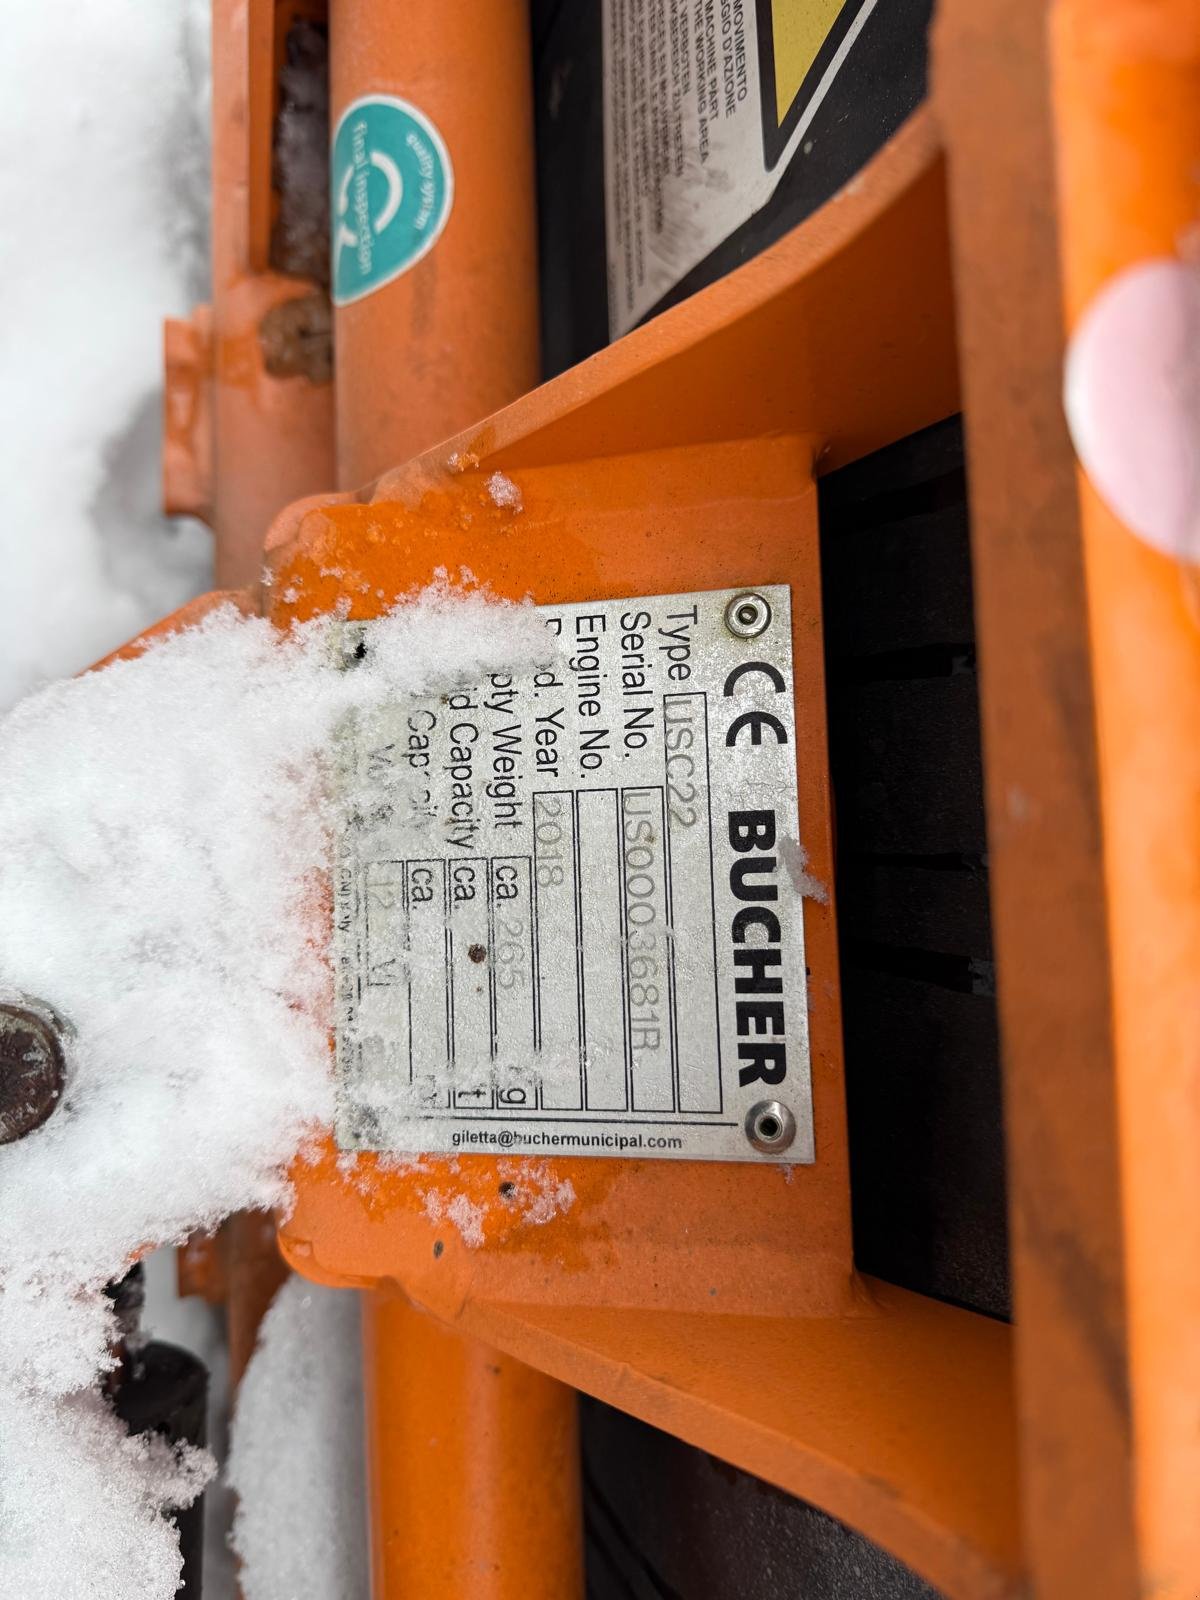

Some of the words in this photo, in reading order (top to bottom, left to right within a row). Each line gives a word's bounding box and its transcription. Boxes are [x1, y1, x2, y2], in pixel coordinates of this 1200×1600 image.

[694, 32, 707, 112] WORKING
[704, 0, 716, 76] MACHINE
[708, 78, 719, 121] PART
[723, 37, 736, 118] D'AZIONE
[352, 121, 369, 169] final
[700, 118, 709, 164] AREA
[354, 170, 375, 275] inspection
[569, 614, 608, 717] Engine
[620, 611, 653, 696] Serial
[658, 605, 698, 681] Type
[483, 673, 519, 714] pty
[535, 706, 566, 778] Year
[579, 729, 610, 779] No.
[623, 707, 655, 758] No.
[664, 699, 696, 828] USC22
[443, 722, 480, 849] Capacity
[486, 724, 524, 829] Weight
[535, 797, 565, 888] 2018
[411, 868, 434, 910] ca.
[453, 866, 476, 910] ca.
[496, 865, 519, 908] ca.
[498, 918, 525, 990] 265
[728, 809, 787, 1087] BUCHER
[452, 1130, 682, 1150] giletta@buchermunicipal.com
